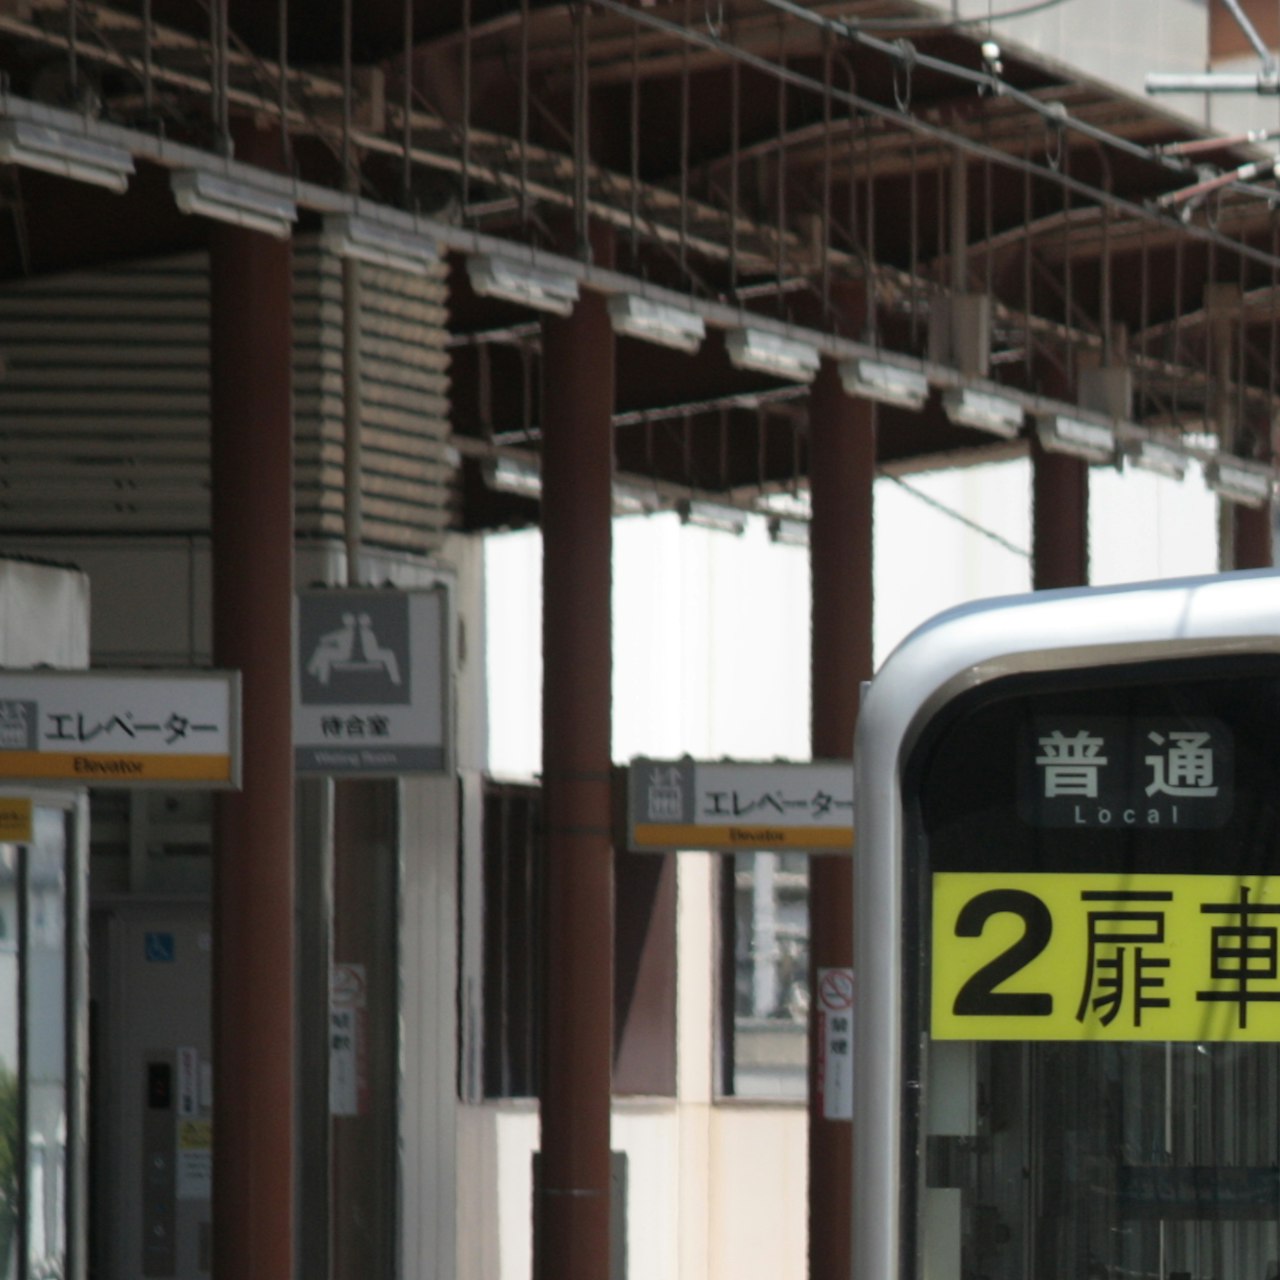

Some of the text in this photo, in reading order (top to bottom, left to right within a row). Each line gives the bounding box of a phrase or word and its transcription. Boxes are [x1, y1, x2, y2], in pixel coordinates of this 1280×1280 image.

[44, 710, 219, 744] エレベーター
[321, 715, 390, 738] 待合室
[73, 756, 144, 775] Elevator
[1035, 730, 1219, 798] 普通
[1075, 805, 1179, 823] Local
